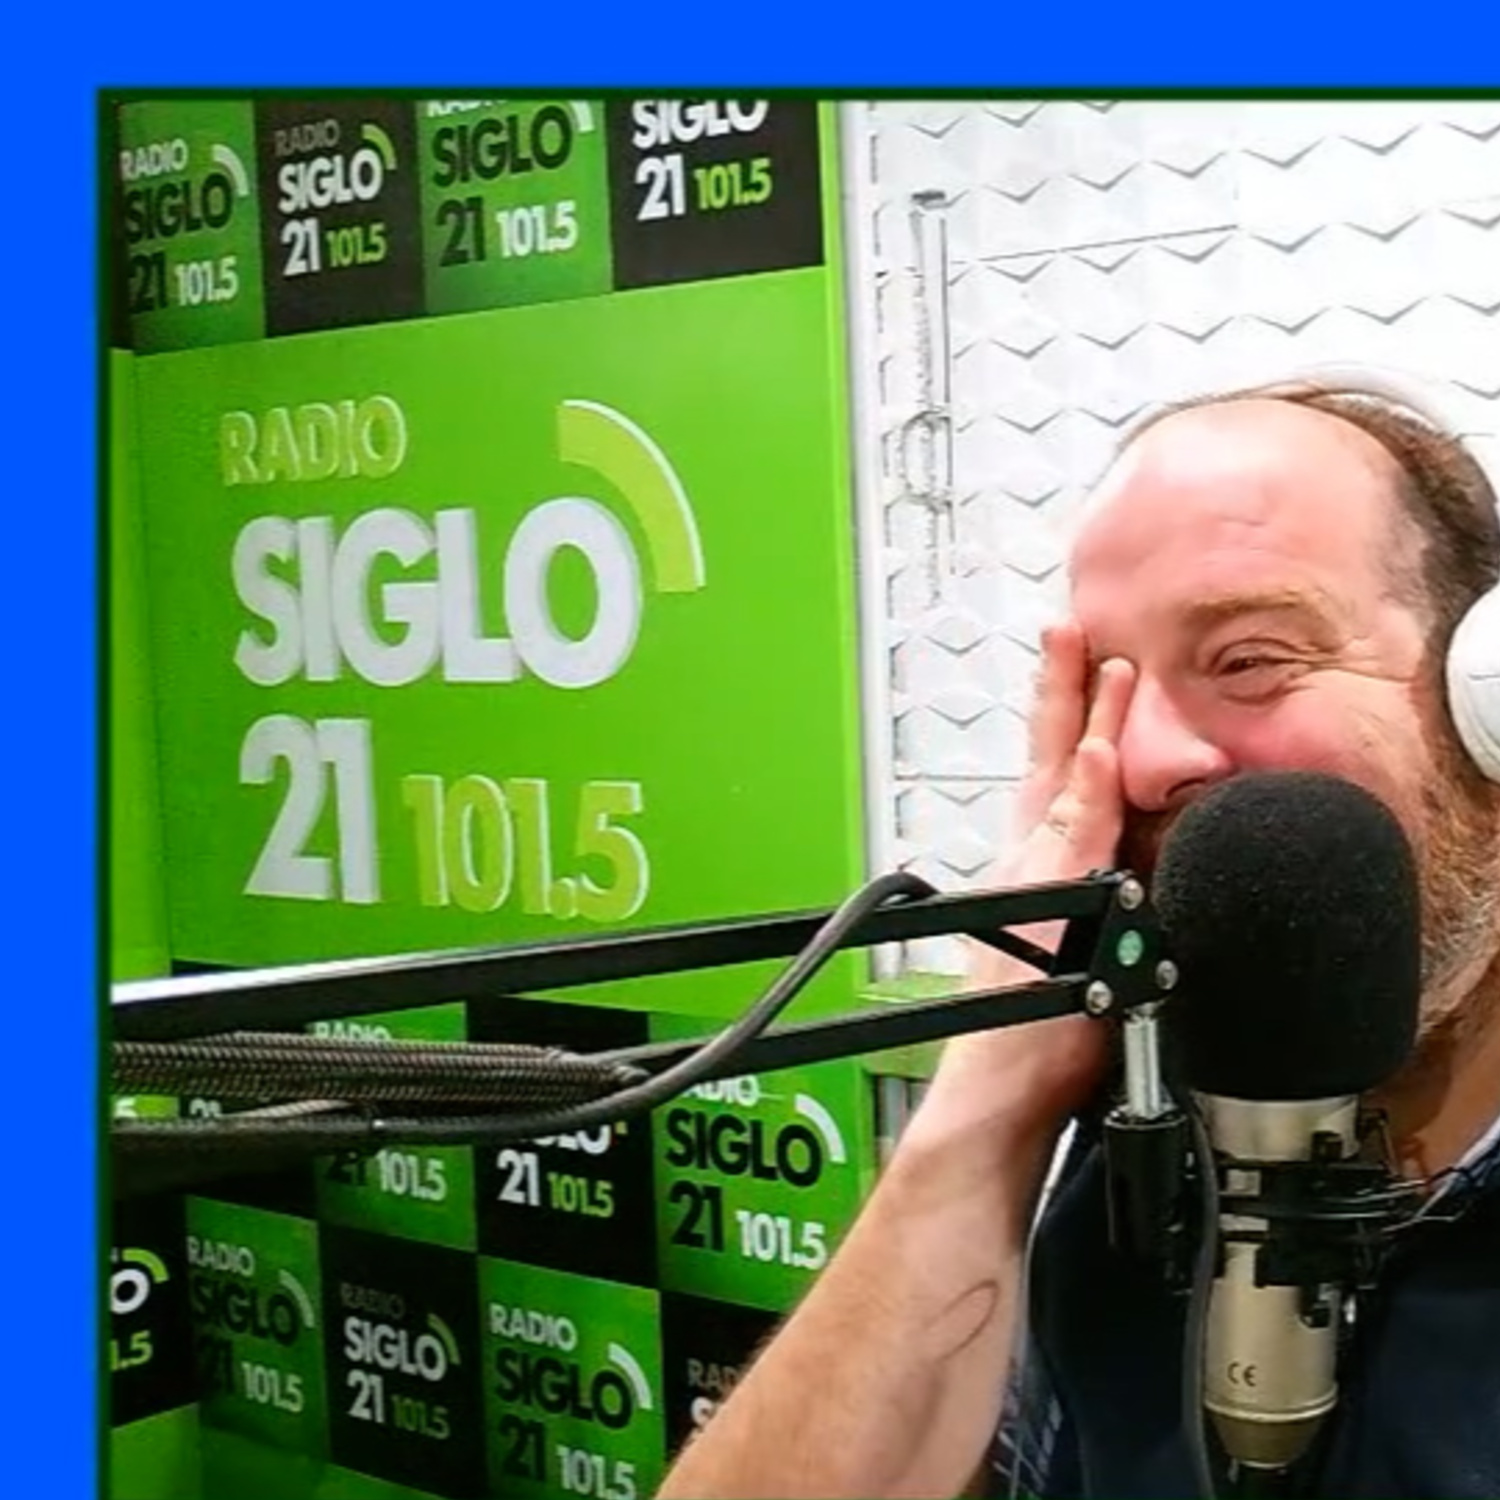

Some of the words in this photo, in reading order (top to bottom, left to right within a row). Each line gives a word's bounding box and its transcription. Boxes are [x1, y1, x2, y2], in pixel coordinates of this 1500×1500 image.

[120, 138, 189, 181] RADIO
[275, 119, 340, 156] RADIO
[431, 104, 573, 188] SIGLO
[126, 173, 232, 243] SIGLO
[277, 148, 383, 214] SIGLO
[635, 153, 686, 221] 21
[694, 157, 773, 210] 101.5
[281, 217, 321, 276] 21
[325, 223, 387, 267] 101.5
[436, 196, 487, 268] 21
[496, 200, 579, 258] 101.5
[128, 251, 168, 314] 21
[174, 255, 239, 306] 101.5
[219, 395, 408, 486] RADIO
[231, 496, 645, 689] SIGLO
[239, 714, 382, 905] 21
[402, 773, 651, 921] 101.5
[374, 1149, 447, 1201] 101.5
[665, 1107, 823, 1188] SIGLO
[496, 1148, 541, 1207] 21
[547, 1171, 615, 1219] 101.5
[186, 1235, 256, 1277] RADIO
[669, 1179, 725, 1254] 21
[735, 1210, 828, 1271] 101.5
[344, 1315, 447, 1382] SIGLO
[489, 1302, 578, 1351] RADIO
[241, 1360, 304, 1413] 101.5
[347, 1368, 386, 1424] 21
[391, 1393, 451, 1440] 101.5
[495, 1346, 632, 1431] SIGLO
[499, 1413, 546, 1482] 21
